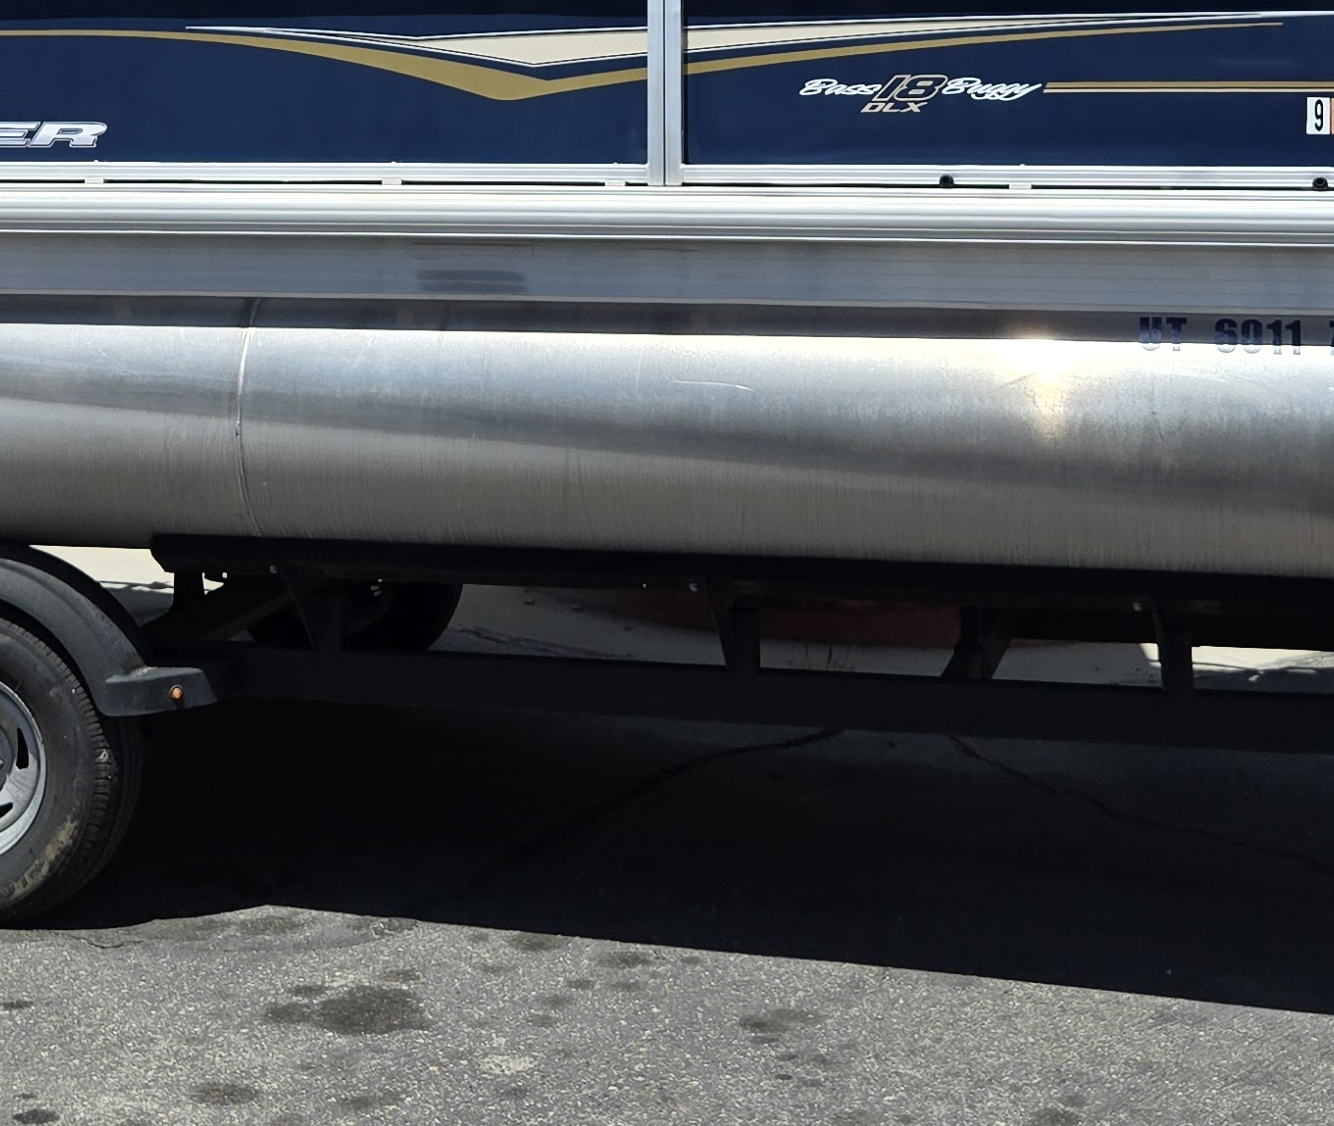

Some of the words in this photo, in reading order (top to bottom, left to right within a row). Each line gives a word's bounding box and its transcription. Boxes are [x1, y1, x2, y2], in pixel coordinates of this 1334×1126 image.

[799, 78, 882, 96] Bass
[872, 73, 949, 102] 18
[941, 77, 1043, 101] Buggy
[860, 101, 928, 113] DLX
[1314, 98, 1324, 132] 9
[1139, 316, 1188, 351] UT
[1214, 318, 1302, 354] 6011
